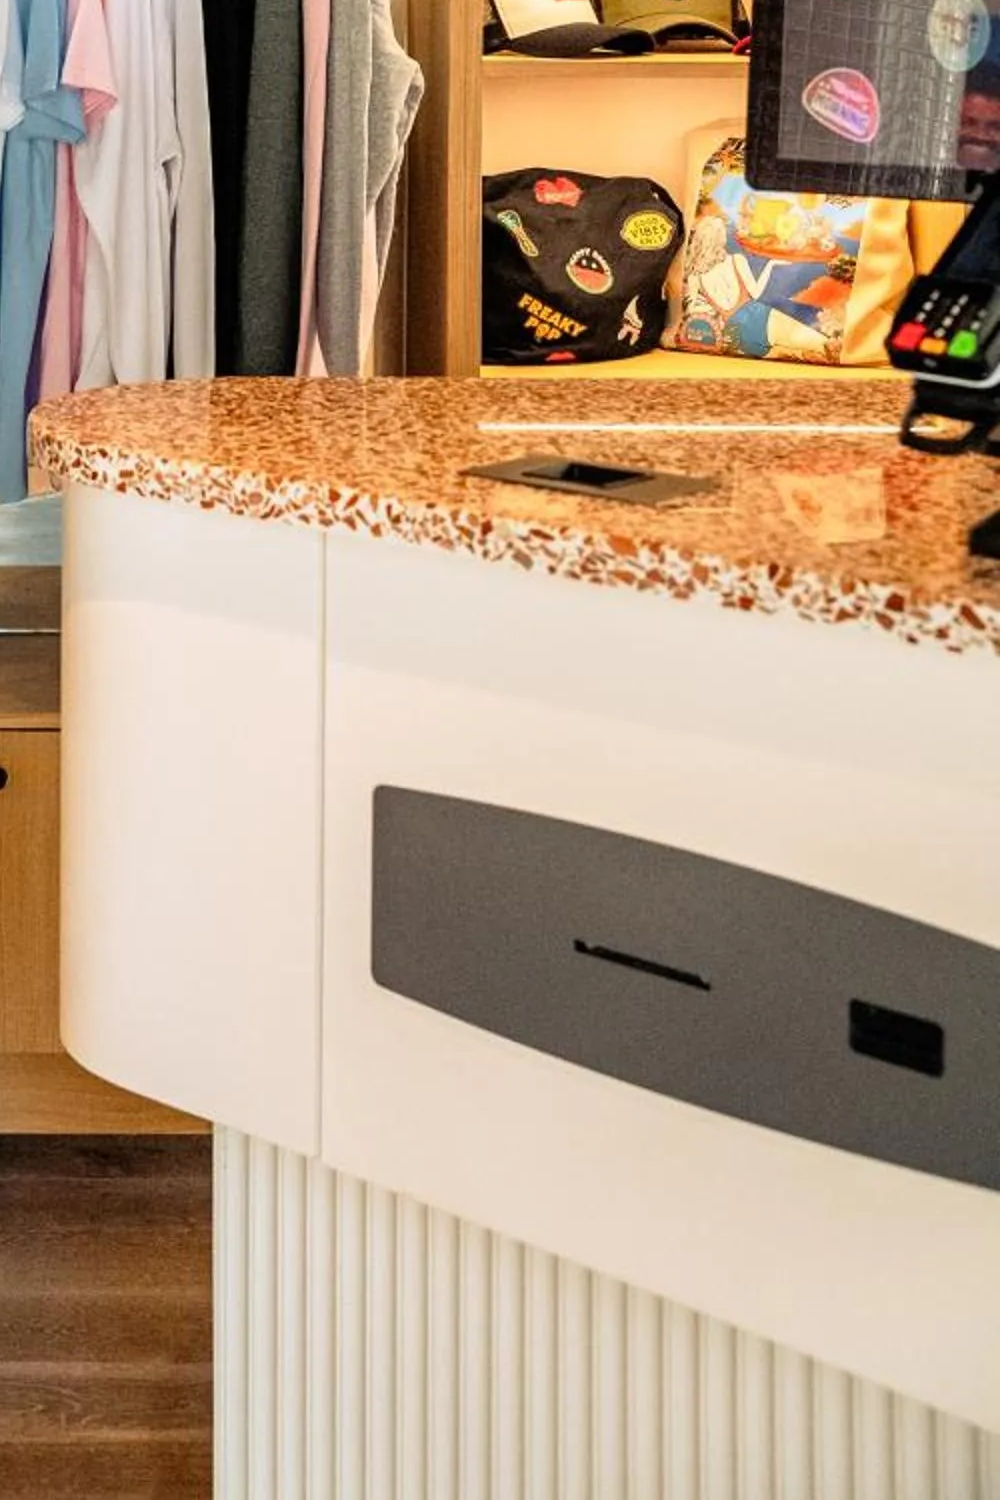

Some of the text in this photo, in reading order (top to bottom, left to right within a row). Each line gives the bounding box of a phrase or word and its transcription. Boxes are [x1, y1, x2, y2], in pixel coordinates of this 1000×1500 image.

[629, 223, 667, 238] VIBES
[518, 293, 588, 338] FREAKY
[524, 316, 563, 342] POP
